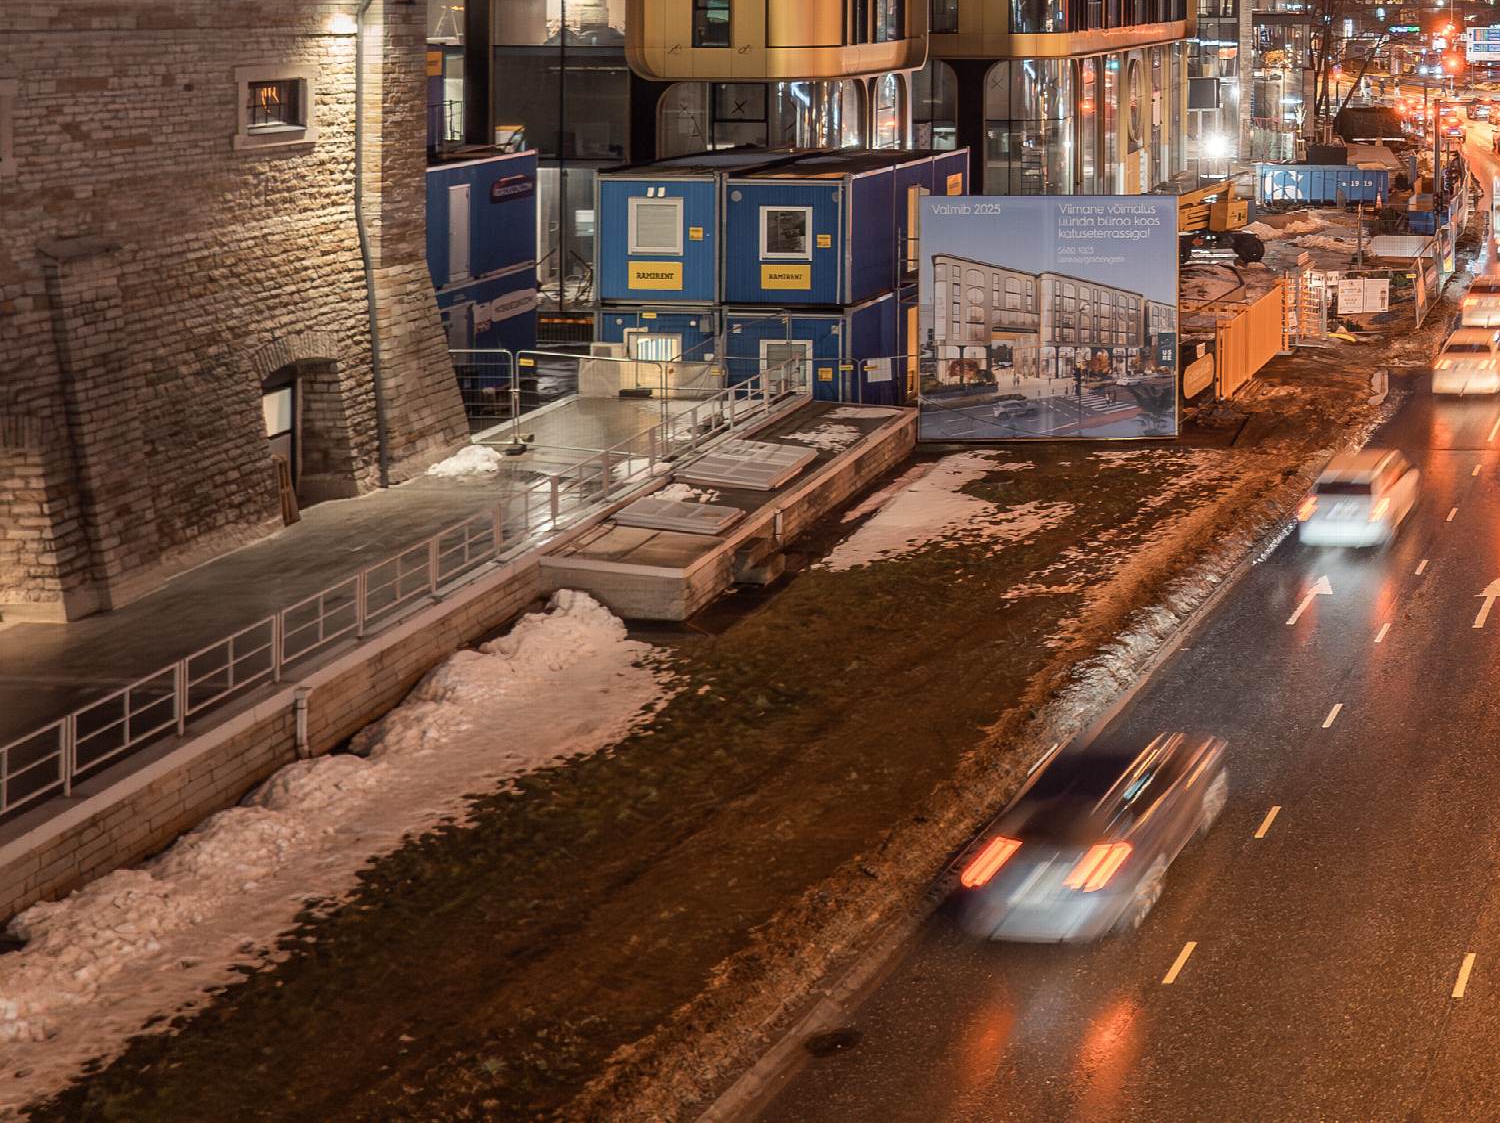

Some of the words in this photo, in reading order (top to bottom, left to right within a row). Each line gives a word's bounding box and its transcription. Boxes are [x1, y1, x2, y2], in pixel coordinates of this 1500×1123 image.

[930, 203, 971, 215] Valmib
[974, 203, 1001, 215] 2025
[1058, 203, 1104, 214] Viimane
[1107, 203, 1157, 214] võimalus
[1134, 216, 1161, 226] koos
[636, 272, 675, 280] RAMIRENT
